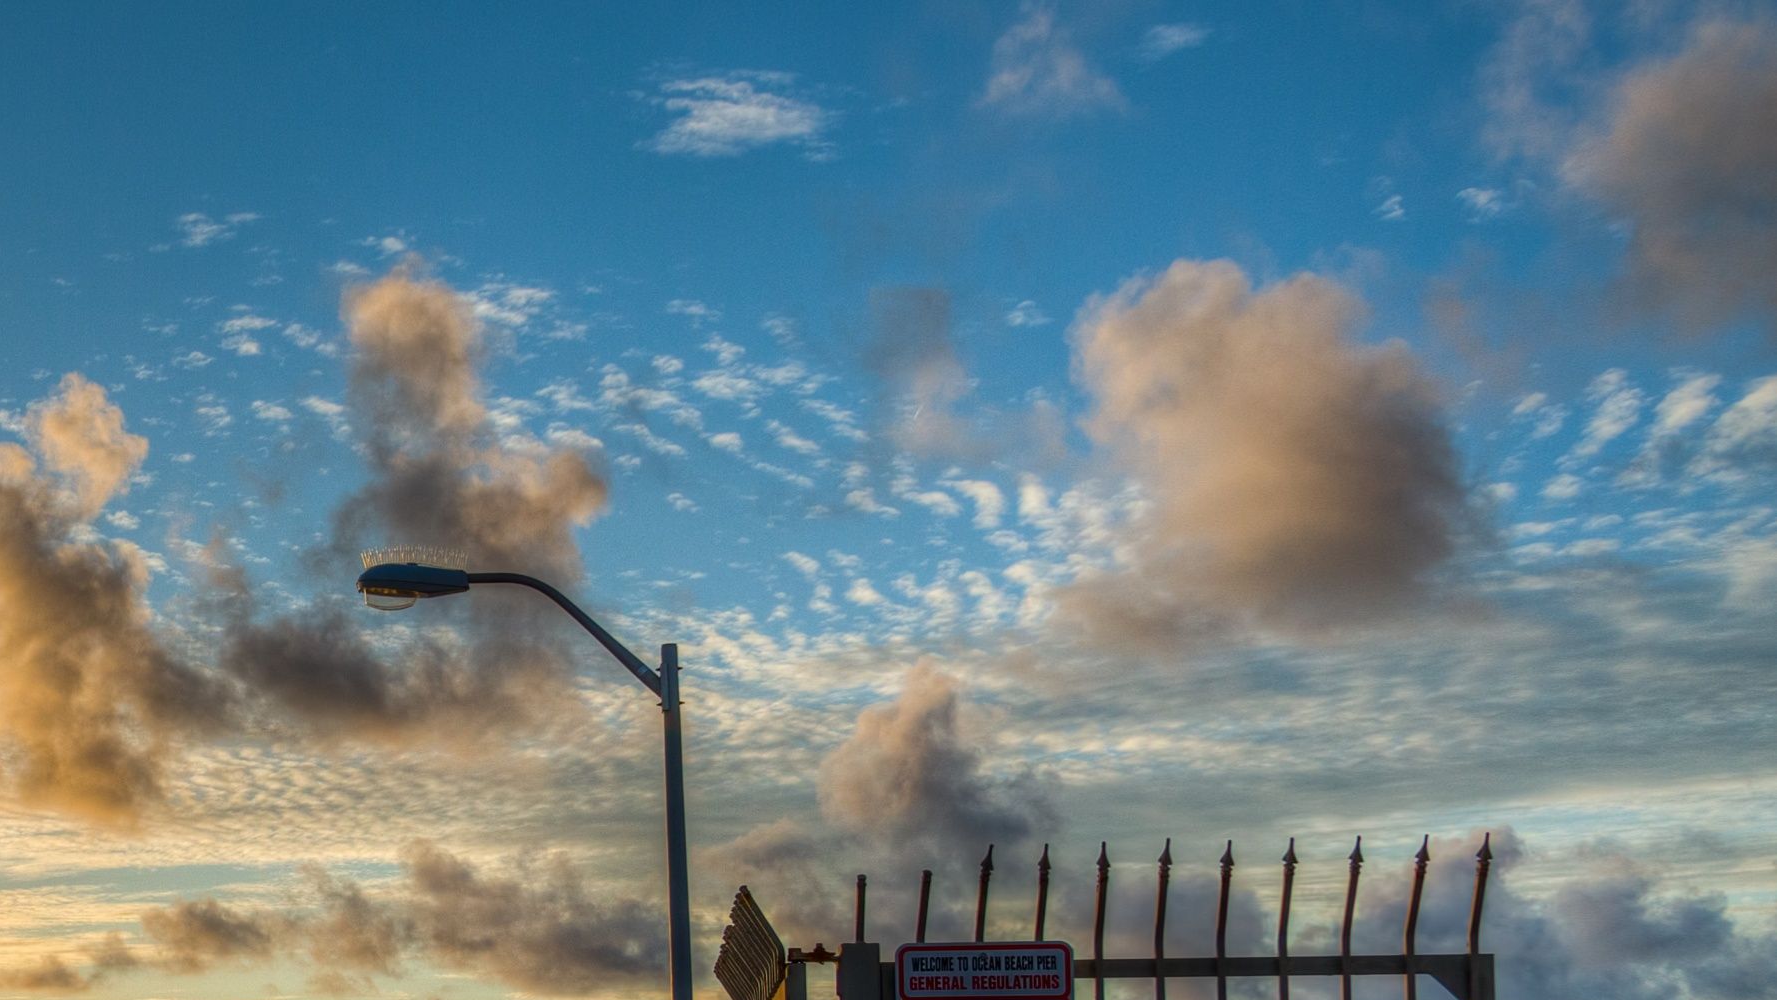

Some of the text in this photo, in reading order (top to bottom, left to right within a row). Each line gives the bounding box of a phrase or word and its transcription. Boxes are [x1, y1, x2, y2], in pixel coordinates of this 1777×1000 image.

[912, 956, 1057, 972] WELCOME TO OCEAN BEACH PIER
[909, 975, 1059, 990] GENERAL REGULATIONS
